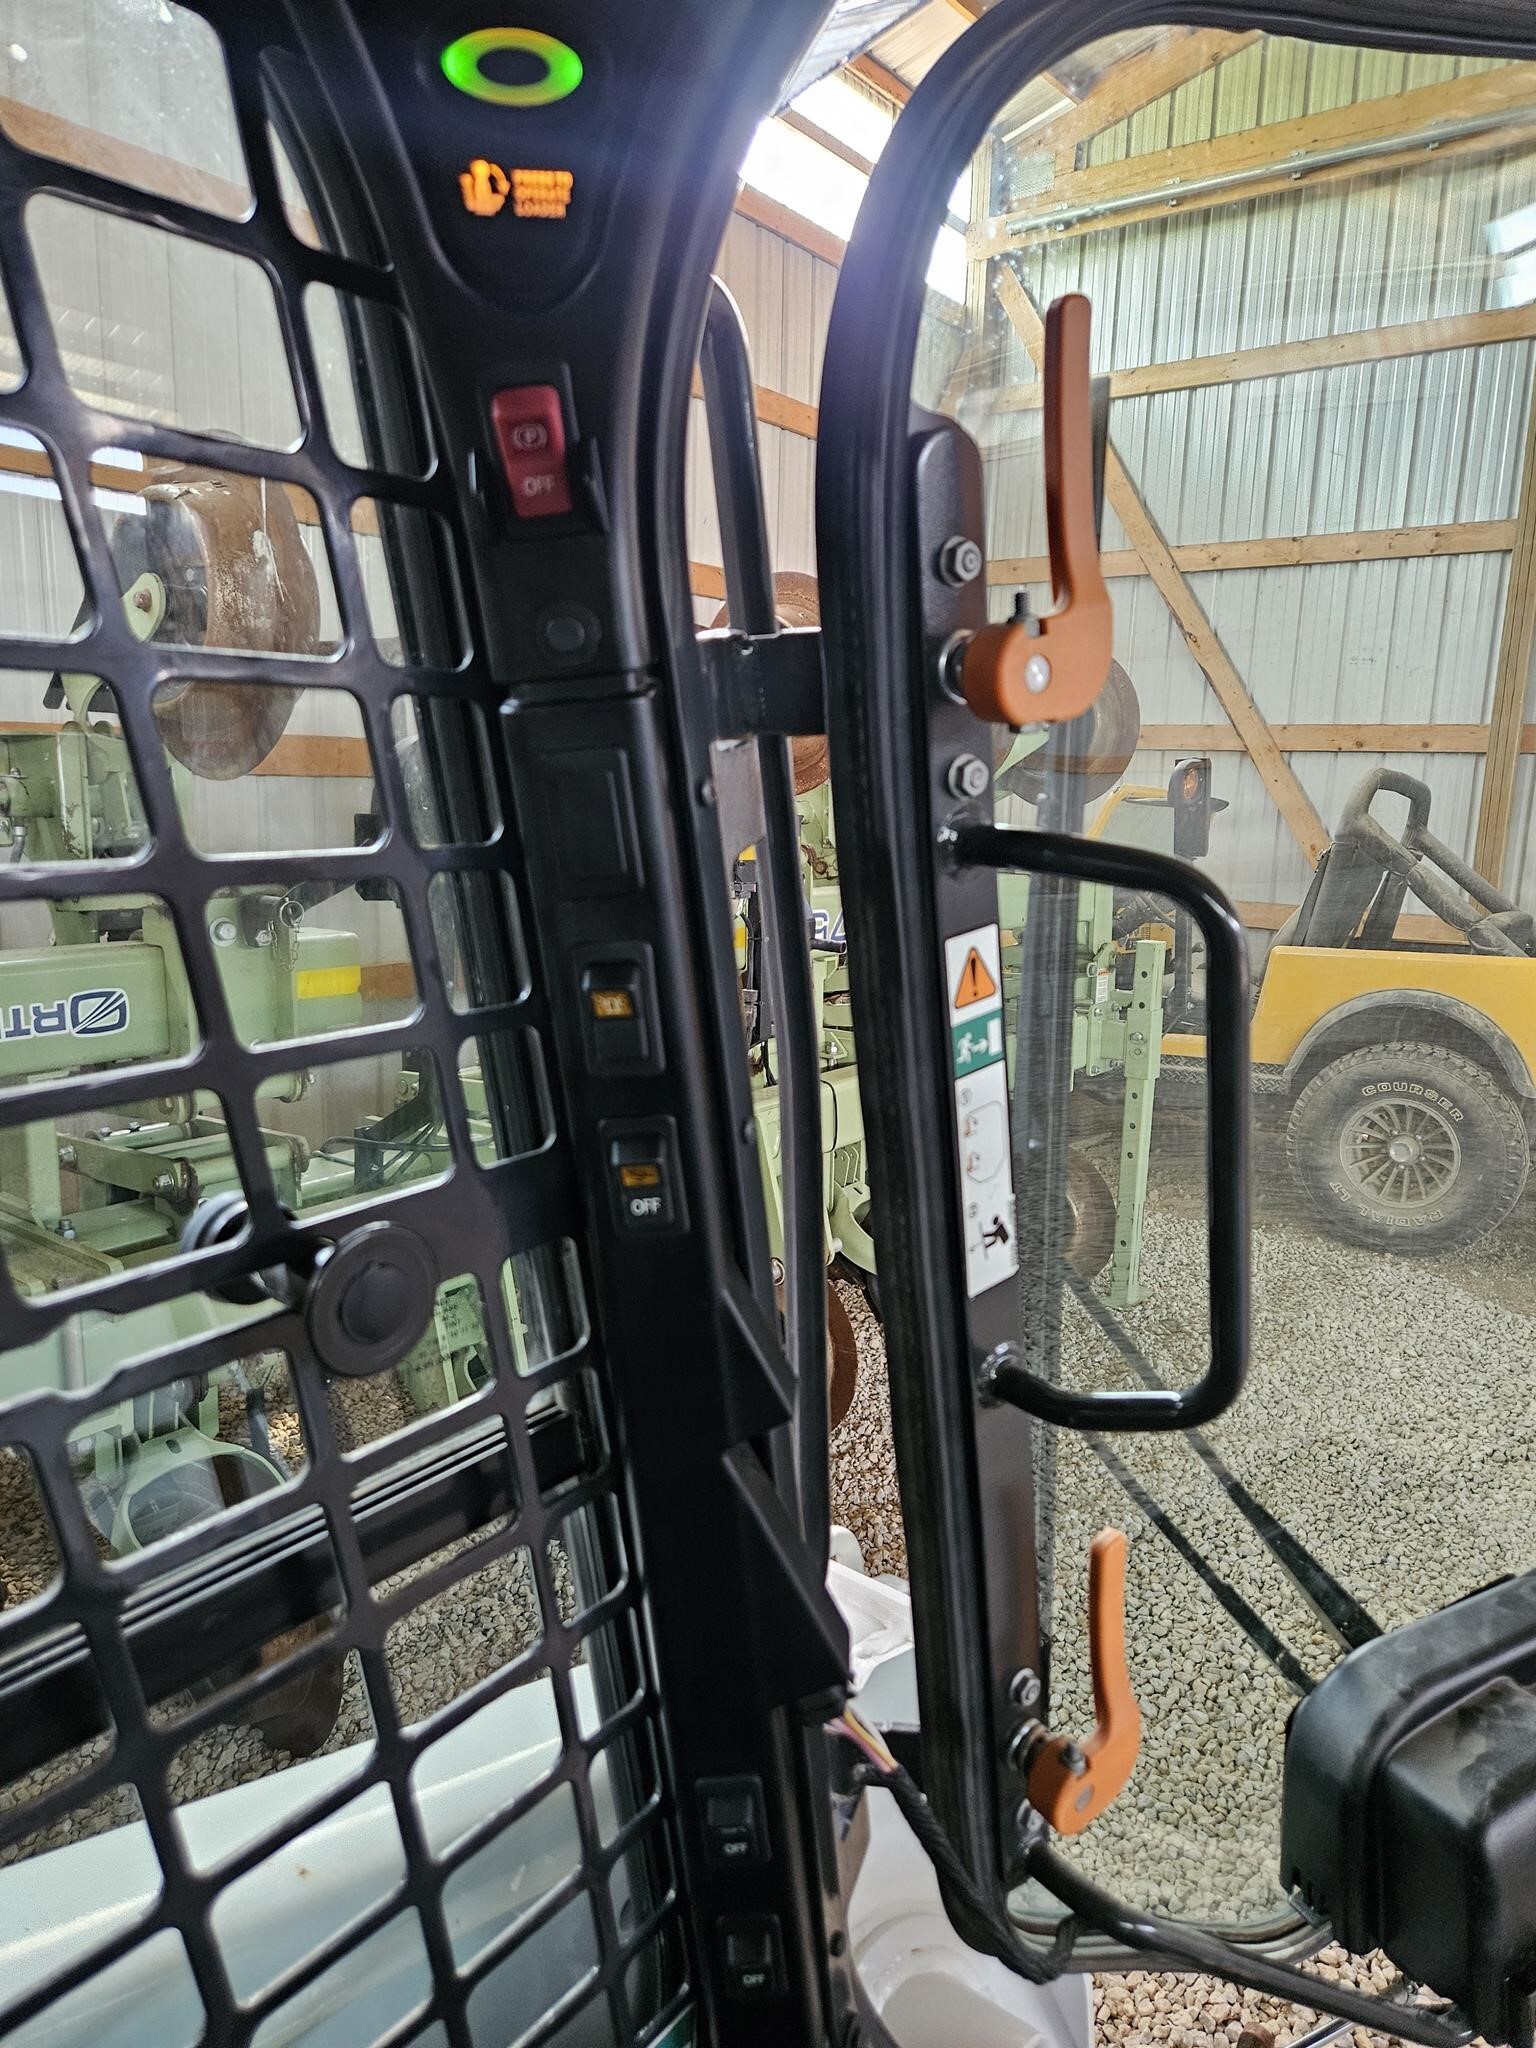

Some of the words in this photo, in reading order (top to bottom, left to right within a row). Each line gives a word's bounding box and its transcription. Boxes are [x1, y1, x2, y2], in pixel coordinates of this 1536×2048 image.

[523, 475, 556, 497] OFF
[0, 989, 128, 1040] ORT
[1362, 1081, 1464, 1122] COURSER
[1329, 1180, 1352, 1202] LT
[630, 1197, 662, 1217] OFF
[1359, 1203, 1444, 1227] RADIAL
[724, 1843, 747, 1855] OFF
[743, 1974, 765, 1985] OFF
